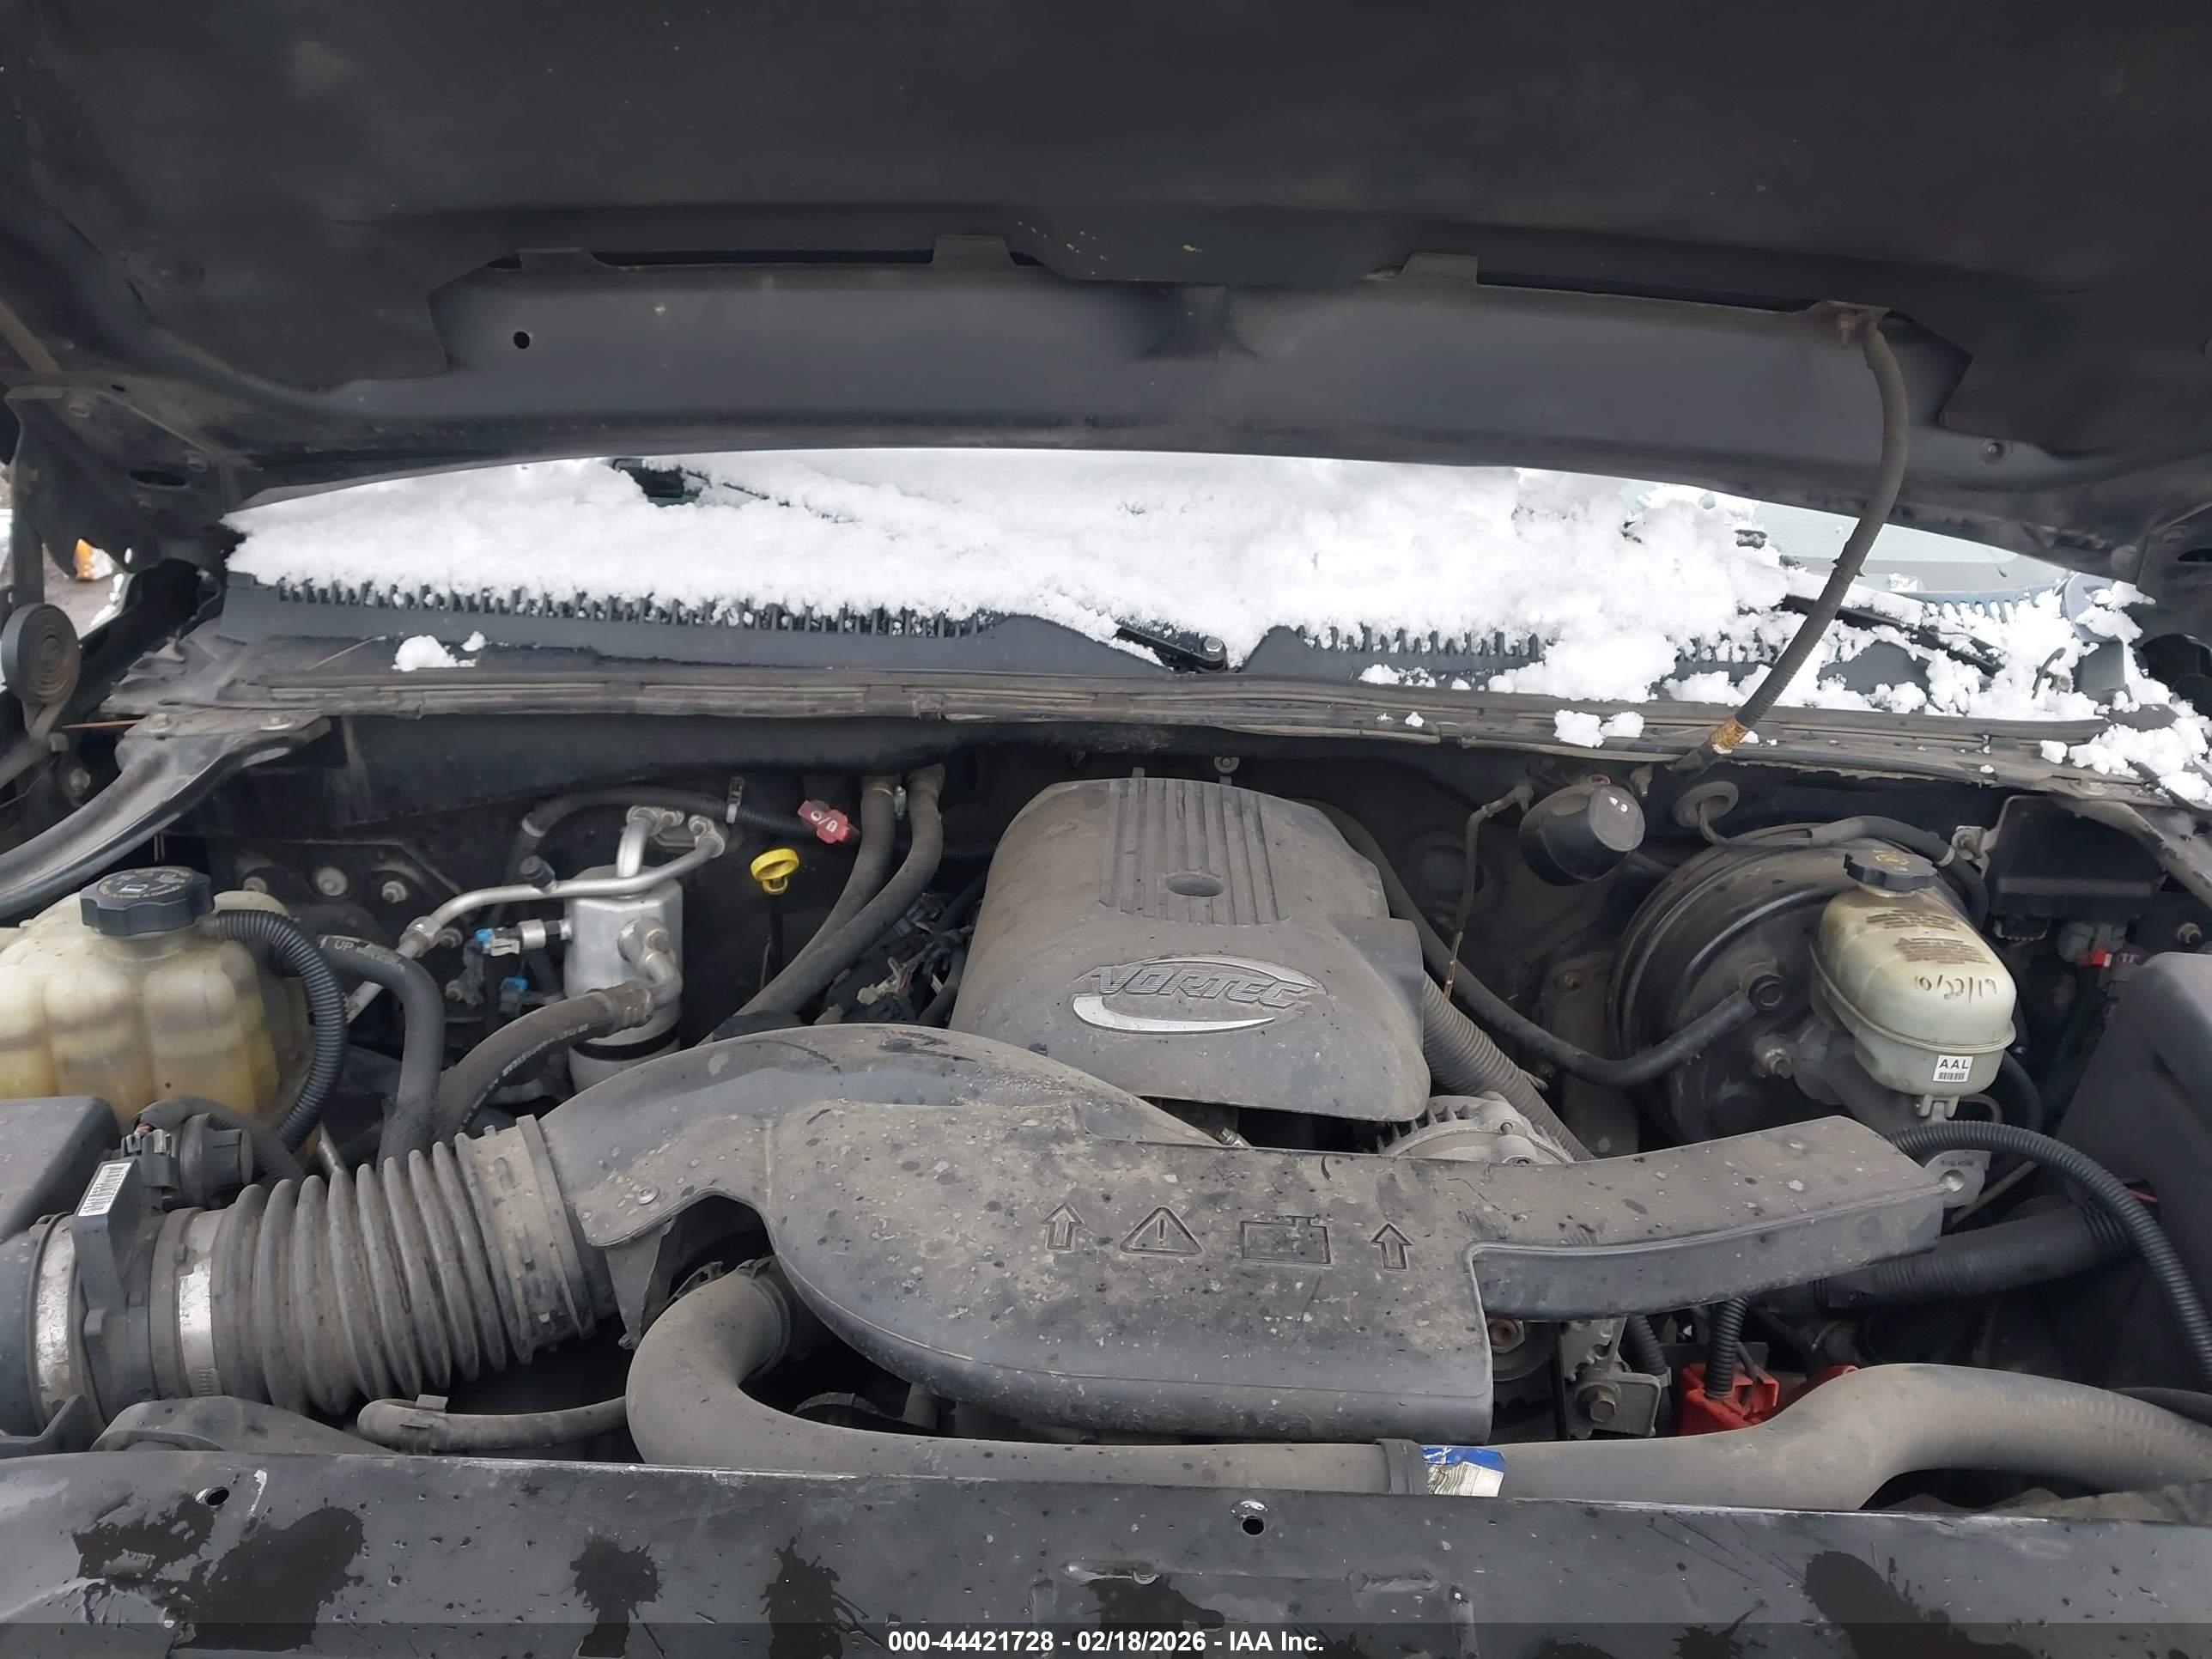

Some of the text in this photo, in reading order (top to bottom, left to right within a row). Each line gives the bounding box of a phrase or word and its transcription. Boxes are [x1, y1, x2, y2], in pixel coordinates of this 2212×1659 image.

[334, 939, 355, 951] UP
[1091, 966, 1309, 1009] VORTEC
[1938, 1059, 1969, 1070] AAL
